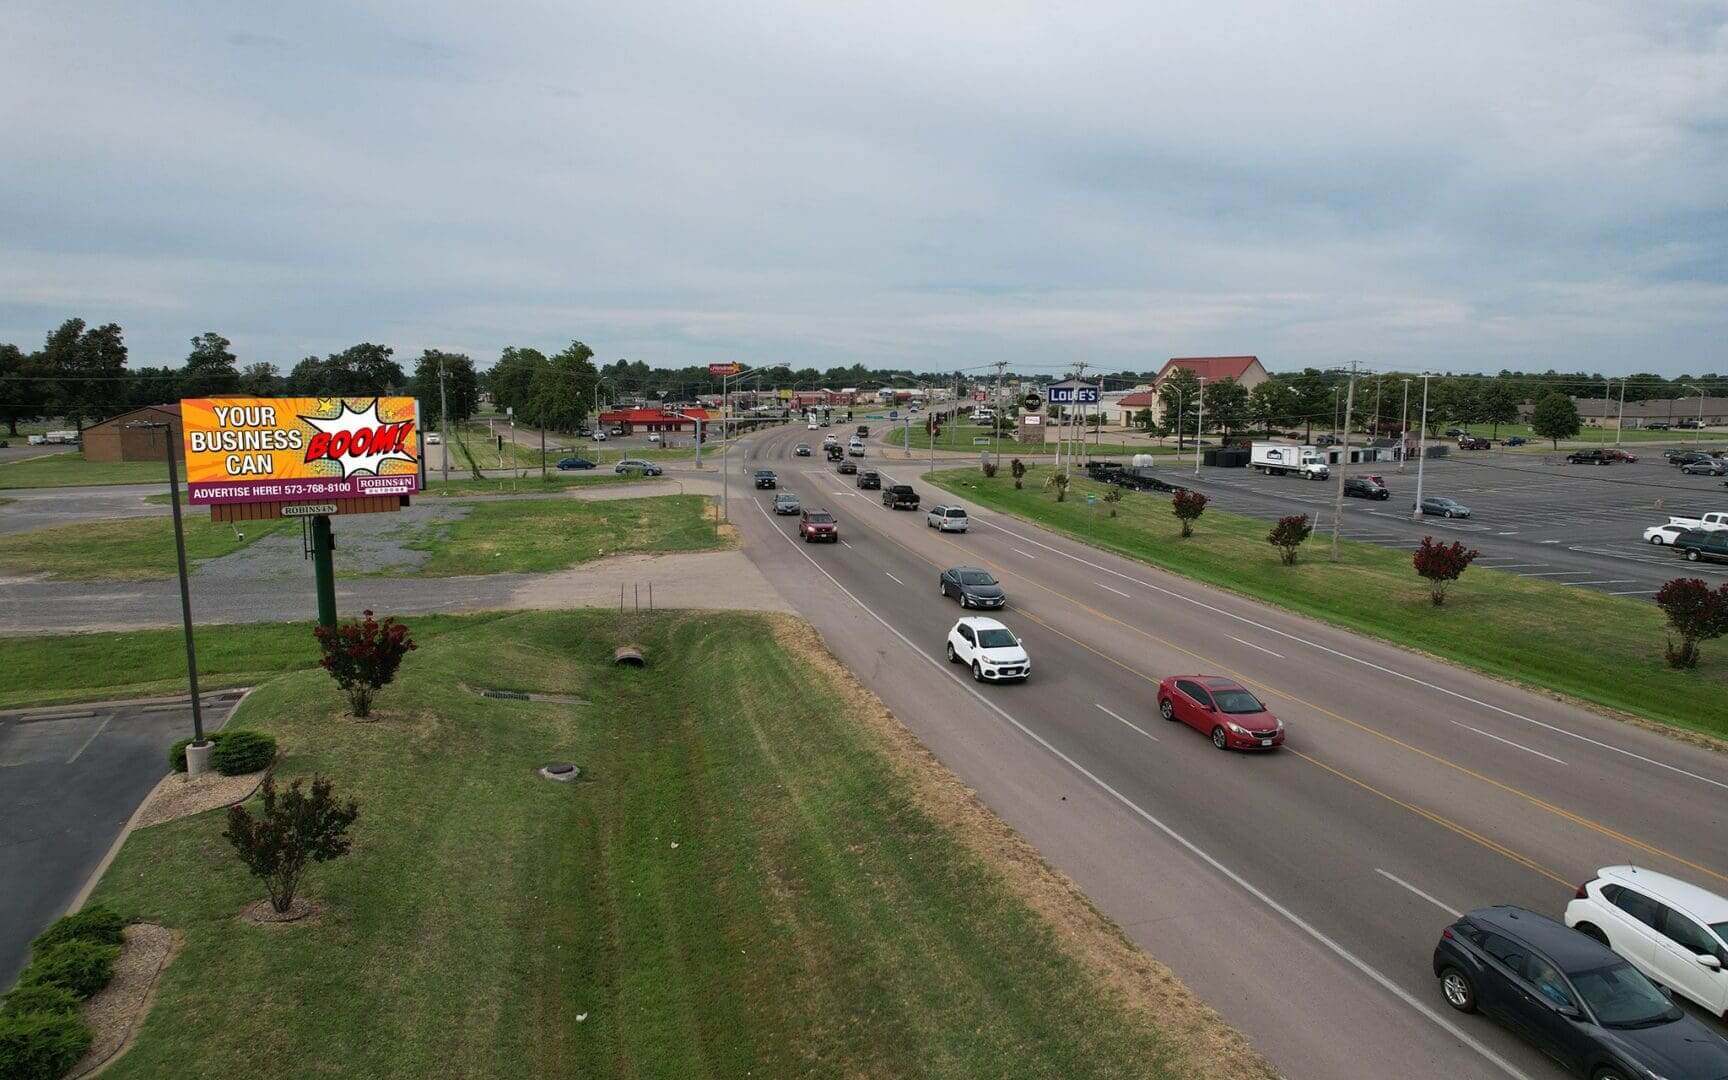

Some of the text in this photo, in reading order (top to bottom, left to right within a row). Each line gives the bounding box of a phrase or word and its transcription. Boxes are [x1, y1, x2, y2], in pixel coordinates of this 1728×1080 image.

[214, 406, 276, 427] YOUR
[190, 430, 303, 452] BUSINESS
[304, 422, 415, 464] BOOM!
[225, 454, 273, 475] CAN
[194, 482, 351, 499] ADVERTISE HERE! 573-768-8100
